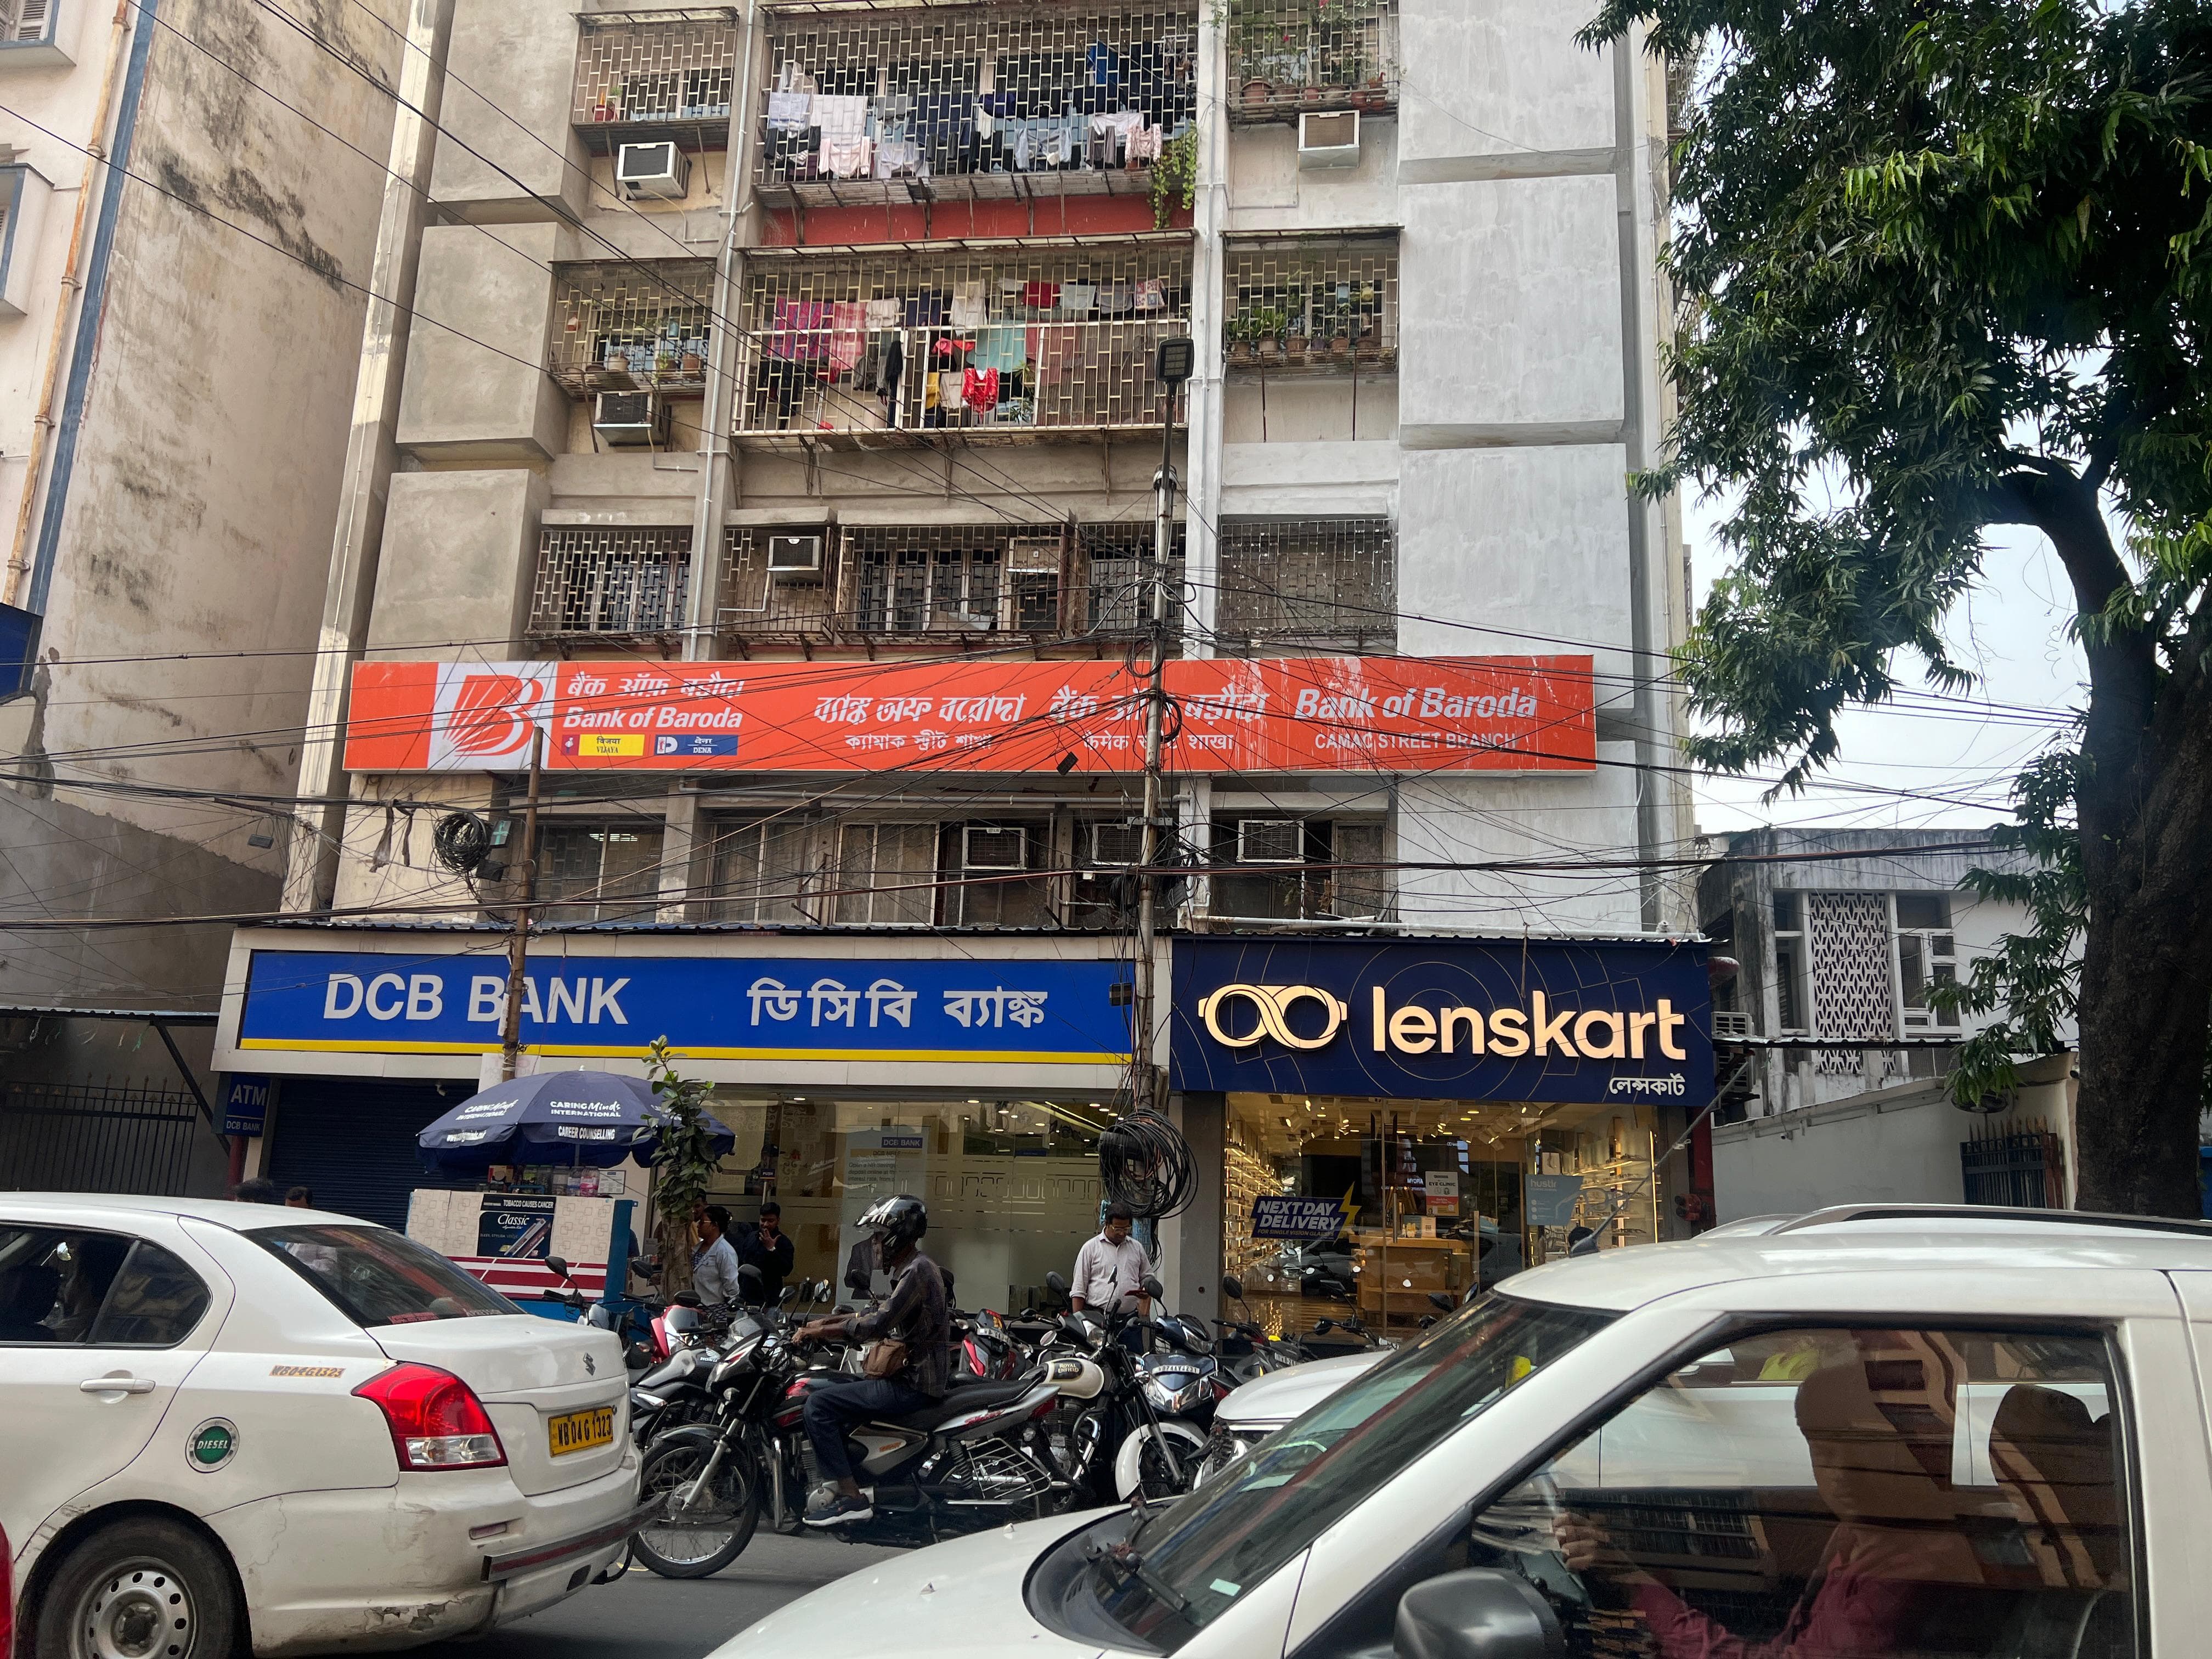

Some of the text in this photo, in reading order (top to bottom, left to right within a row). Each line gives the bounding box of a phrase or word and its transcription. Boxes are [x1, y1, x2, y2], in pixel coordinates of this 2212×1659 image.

[568, 671, 608, 696] बैंक
[814, 693, 1027, 725] ব্যাঙ্ক অফ বরোদা
[1049, 685, 1099, 720] बैंक
[1294, 687, 1537, 719] Bank of Baroda
[563, 707, 743, 728] Bank of Baroda
[596, 736, 621, 744] विजया
[693, 736, 712, 744] देना
[845, 735, 907, 751] ক্যামাক
[1188, 733, 1234, 751] शाखा
[1315, 732, 1516, 749] CAMAC STREET BRANCH
[324, 973, 631, 1024] DCB BANK
[944, 986, 1048, 1028] ব্যাঙ্ক
[1373, 985, 1686, 1061] lenskart
[1609, 1073, 1685, 1096] লেন্সকার্ট
[230, 1084, 267, 1105] ATM
[550, 1101, 621, 1111] CARING Minds
[226, 1121, 261, 1131] DCB BANK
[558, 1126, 616, 1140] CAREER COUNSELLING
[1257, 1200, 1336, 1216] NEXT DAY
[498, 1214, 529, 1226] Classic
[1260, 1215, 1341, 1230] DELIVERY
[272, 1365, 346, 1377] WB04G1323
[197, 1440, 228, 1449] DIESEL
